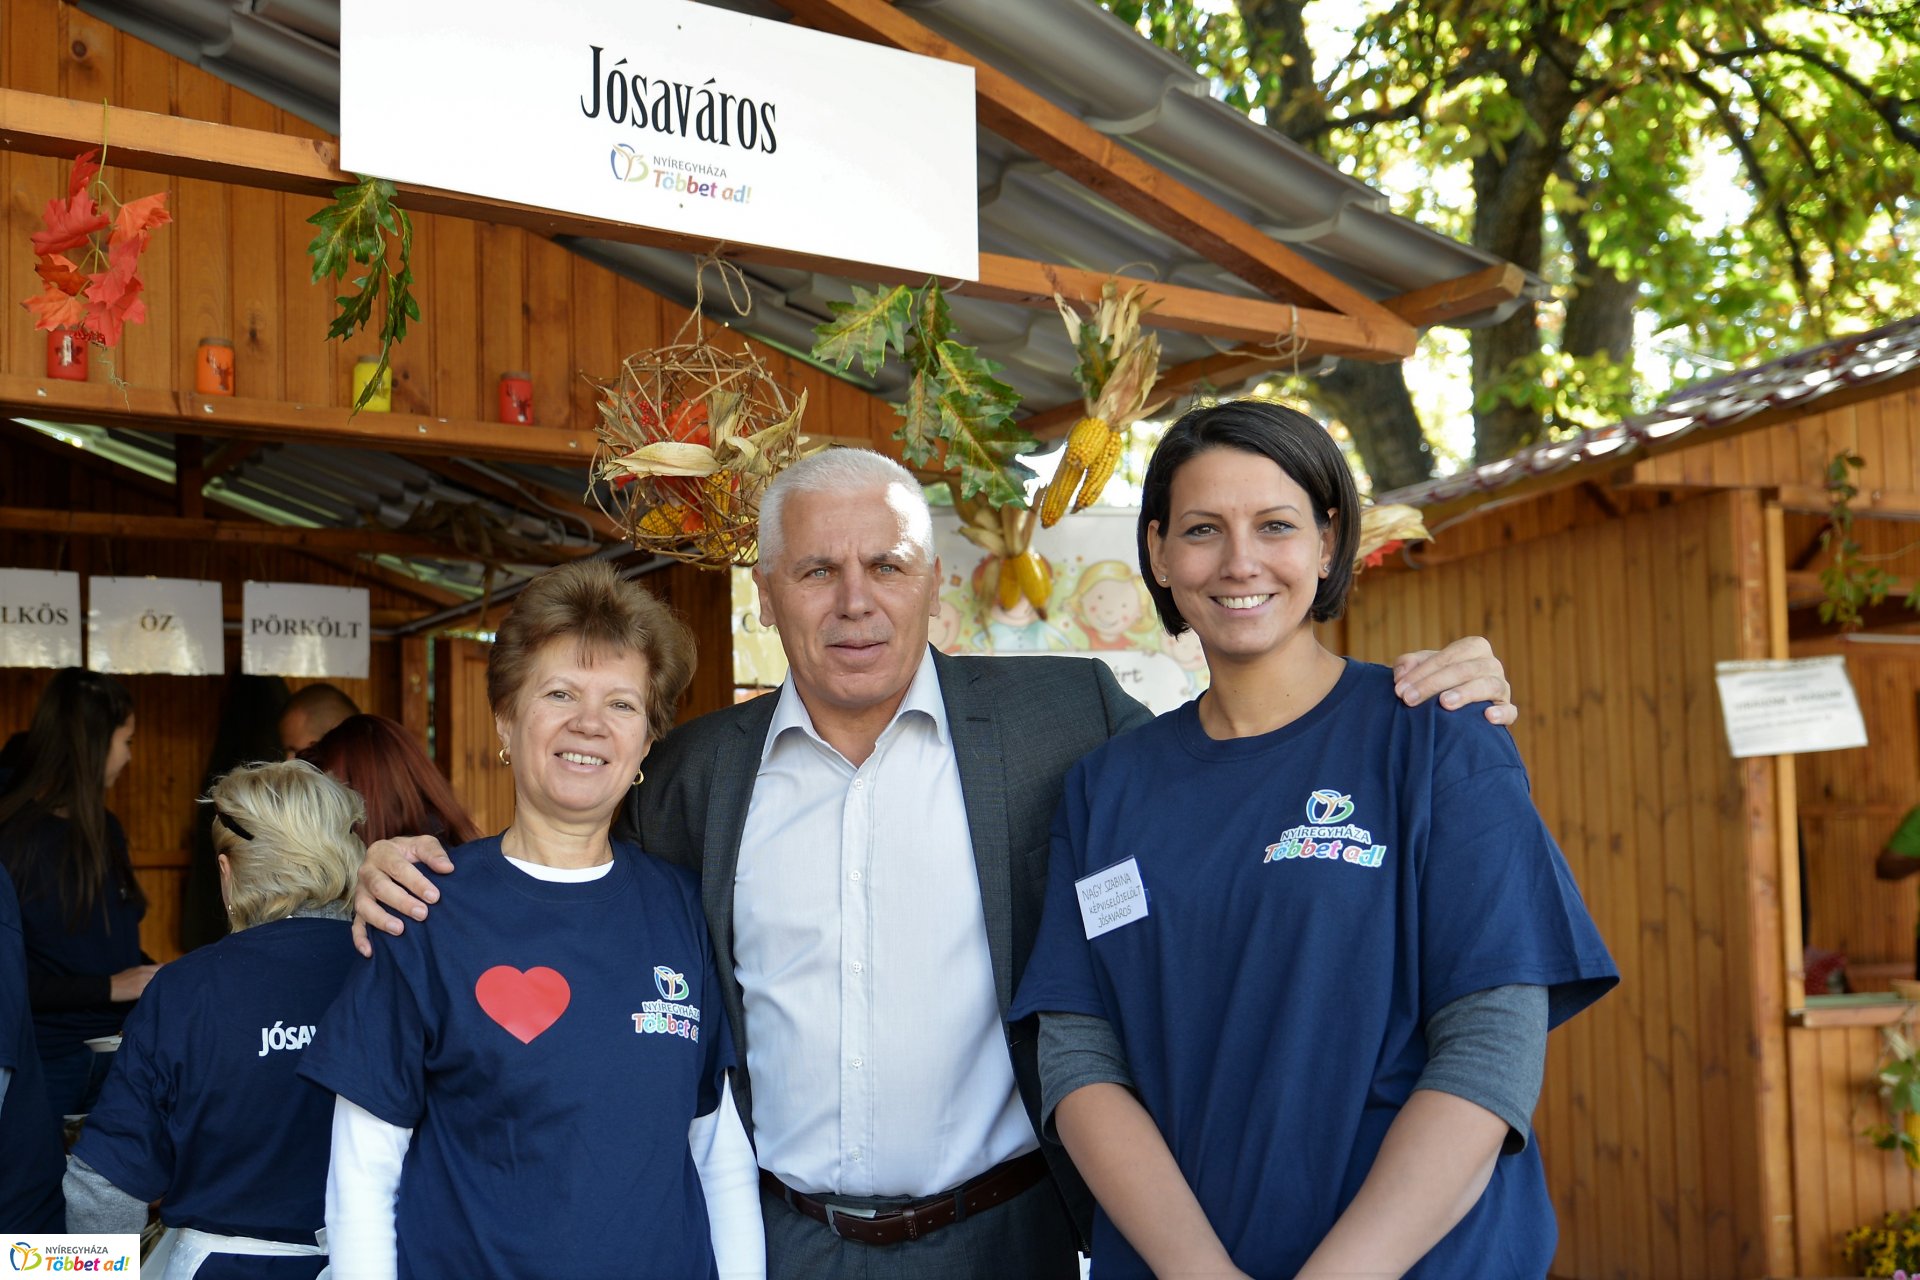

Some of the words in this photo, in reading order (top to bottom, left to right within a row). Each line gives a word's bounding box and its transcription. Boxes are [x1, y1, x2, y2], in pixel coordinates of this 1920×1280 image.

[580, 44, 777, 155] Jósaváros
[653, 155, 728, 179] NYÍREGYHÁZA
[653, 169, 718, 199] Többet
[721, 184, 753, 205] ad!
[251, 614, 362, 639] PÖRKÖLT
[1281, 825, 1372, 845] NYÍREGYHÁZA
[1263, 838, 1342, 863] Többet
[1342, 845, 1387, 868] ad!
[1081, 883, 1103, 902] NAGY
[1104, 872, 1132, 893] SZABINA
[632, 1013, 690, 1038] Többet
